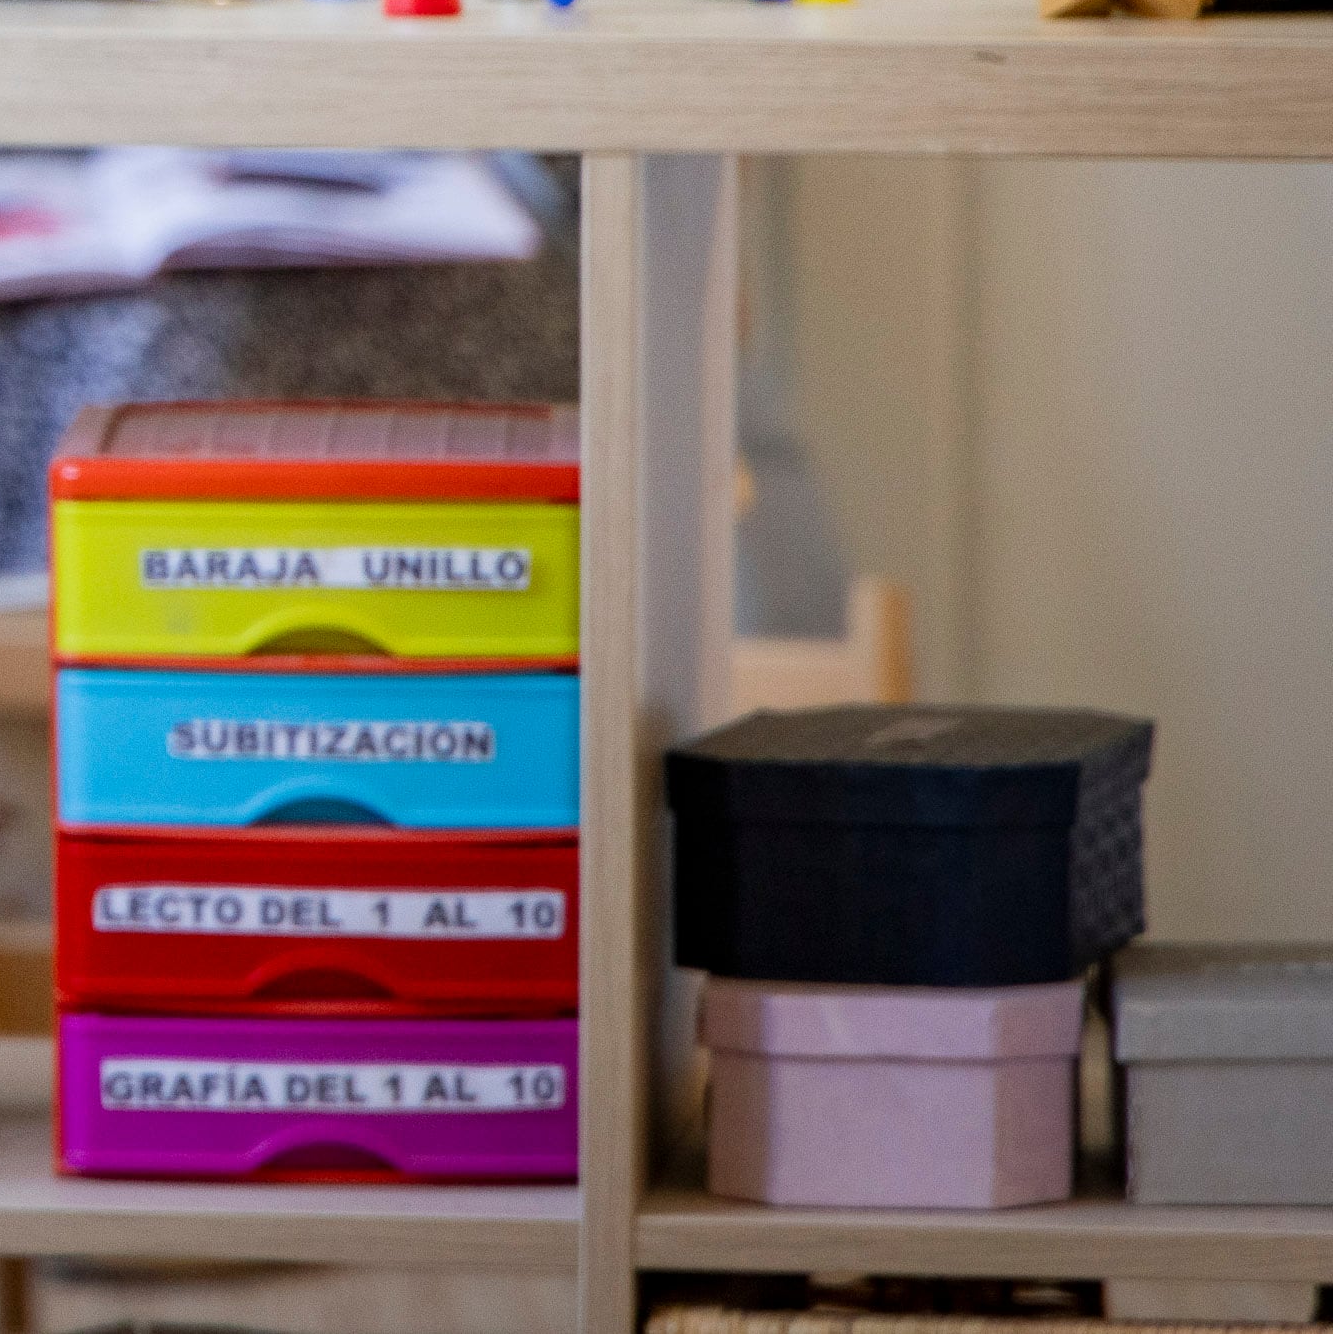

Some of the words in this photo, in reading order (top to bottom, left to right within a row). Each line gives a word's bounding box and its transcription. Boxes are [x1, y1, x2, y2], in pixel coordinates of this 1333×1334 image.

[143, 550, 321, 581] BARAJA
[363, 550, 527, 582] UNILLO
[99, 891, 243, 926] LECTO
[259, 895, 340, 928] DEL
[373, 899, 390, 928] 1
[422, 897, 476, 929] AL
[510, 899, 557, 929] 10
[104, 1065, 267, 1103] GRAFÍA
[284, 1072, 367, 1104] DEL
[384, 1071, 402, 1104] 1
[422, 1072, 476, 1104] AL
[511, 1070, 557, 1103] 10
